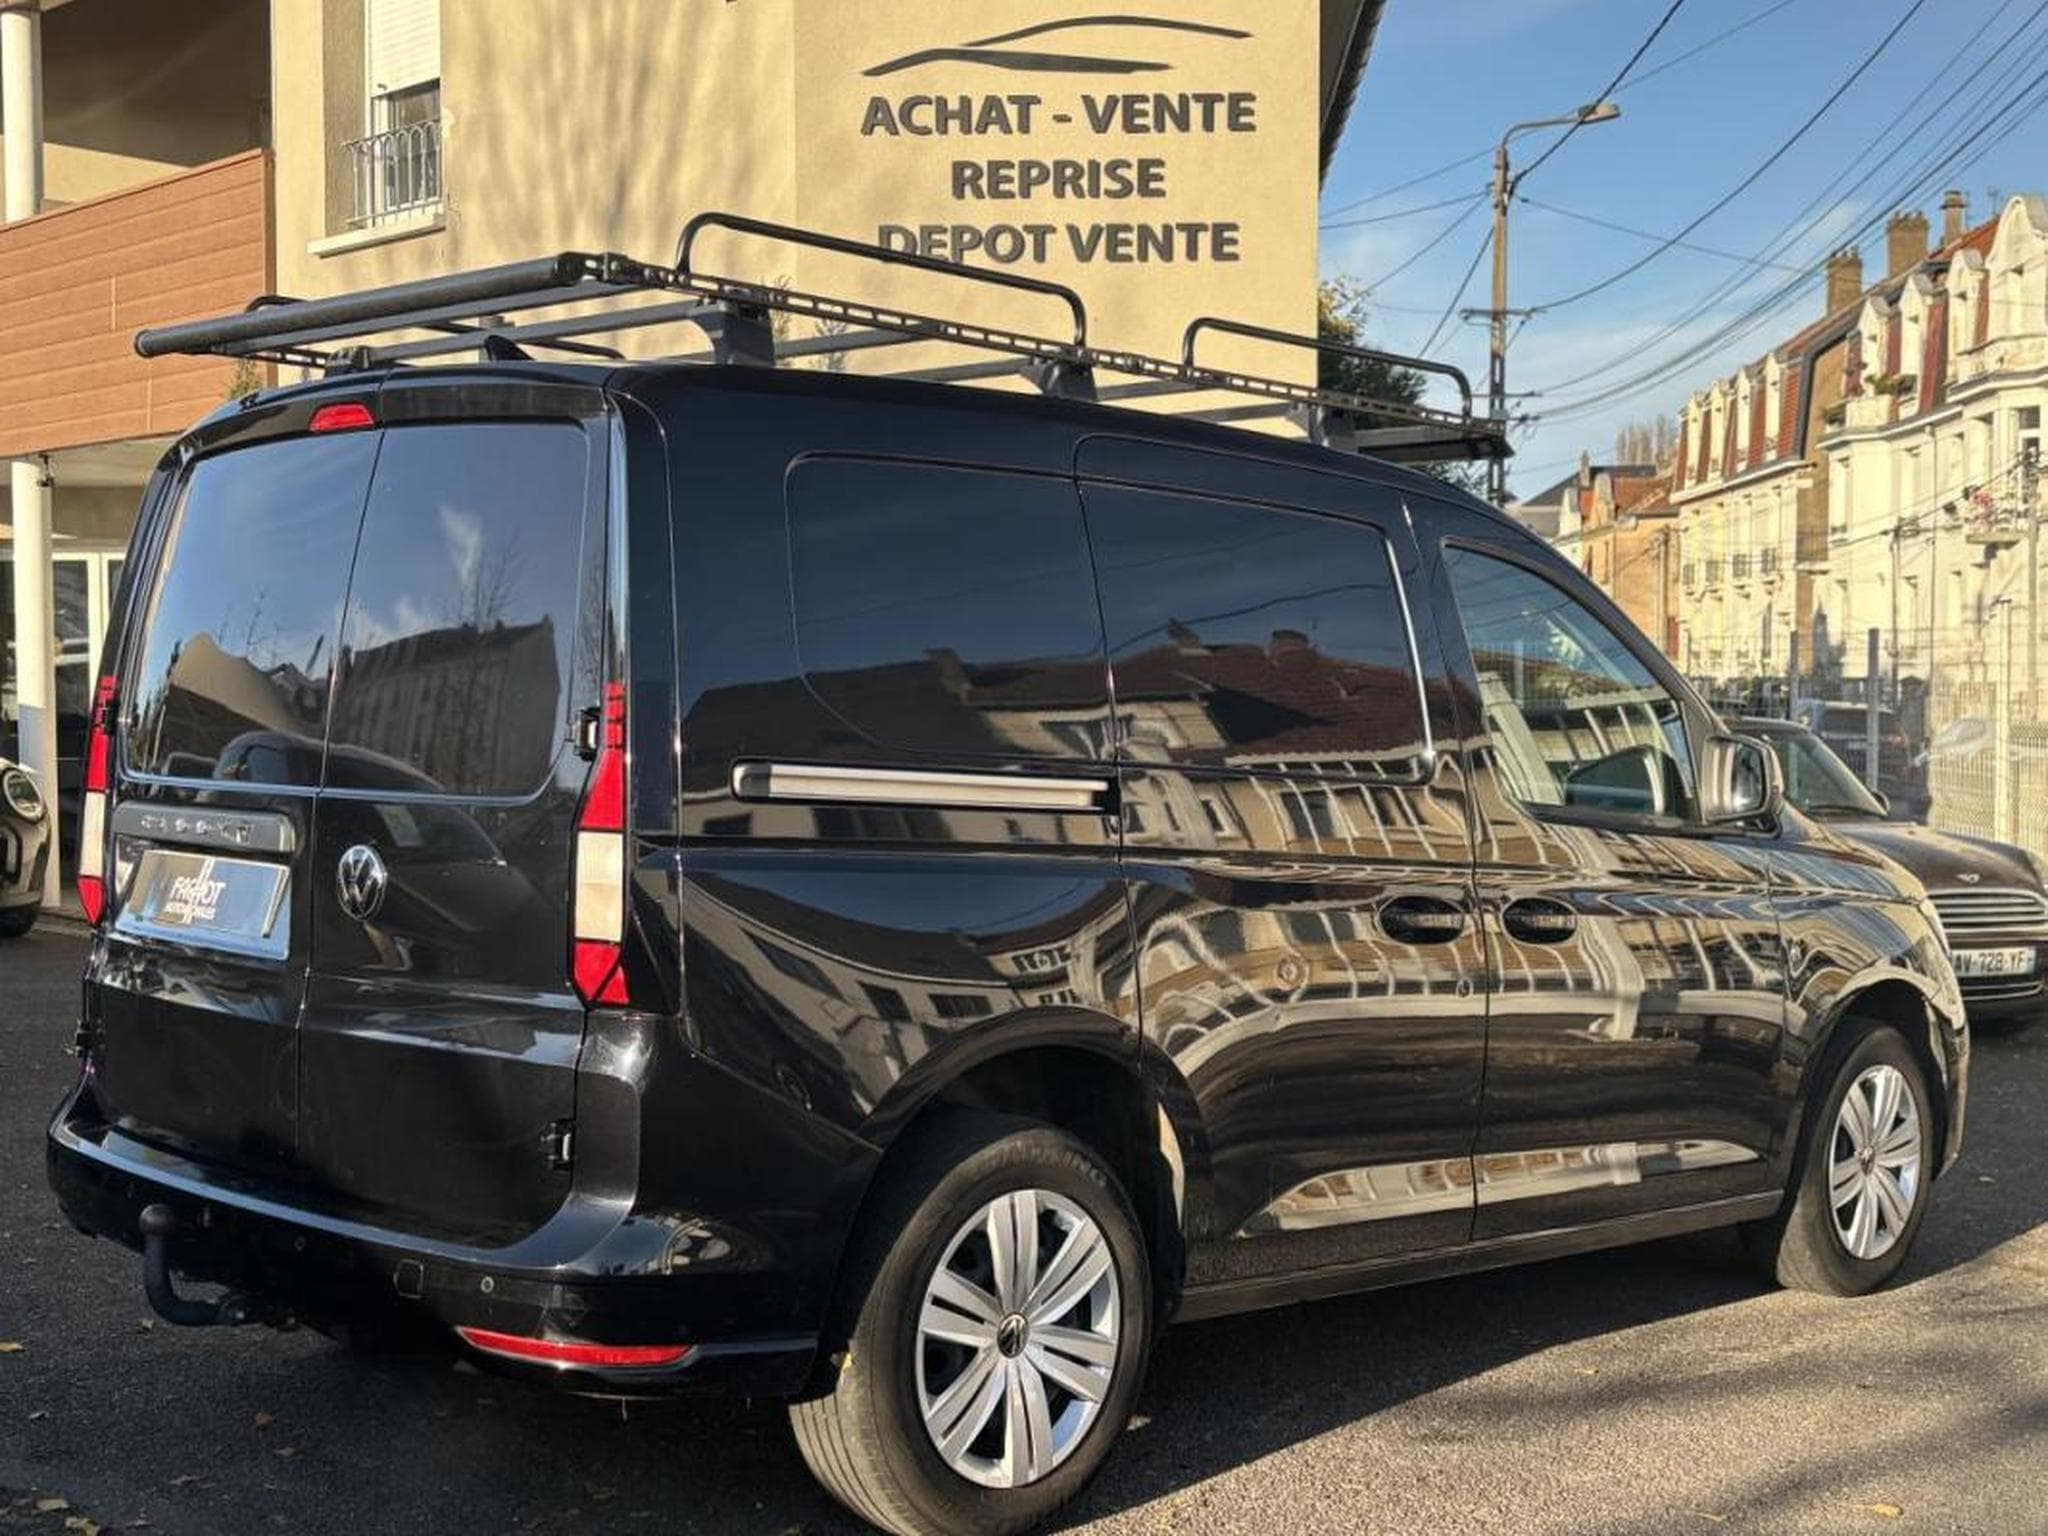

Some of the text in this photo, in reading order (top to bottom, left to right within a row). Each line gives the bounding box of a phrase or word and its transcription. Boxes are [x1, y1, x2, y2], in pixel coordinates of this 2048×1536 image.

[861, 95, 1041, 135] ACHAT
[1080, 92, 1257, 134] VENTE
[951, 158, 1167, 200] REPRISE
[878, 222, 1240, 264] DEPOT VENTE
